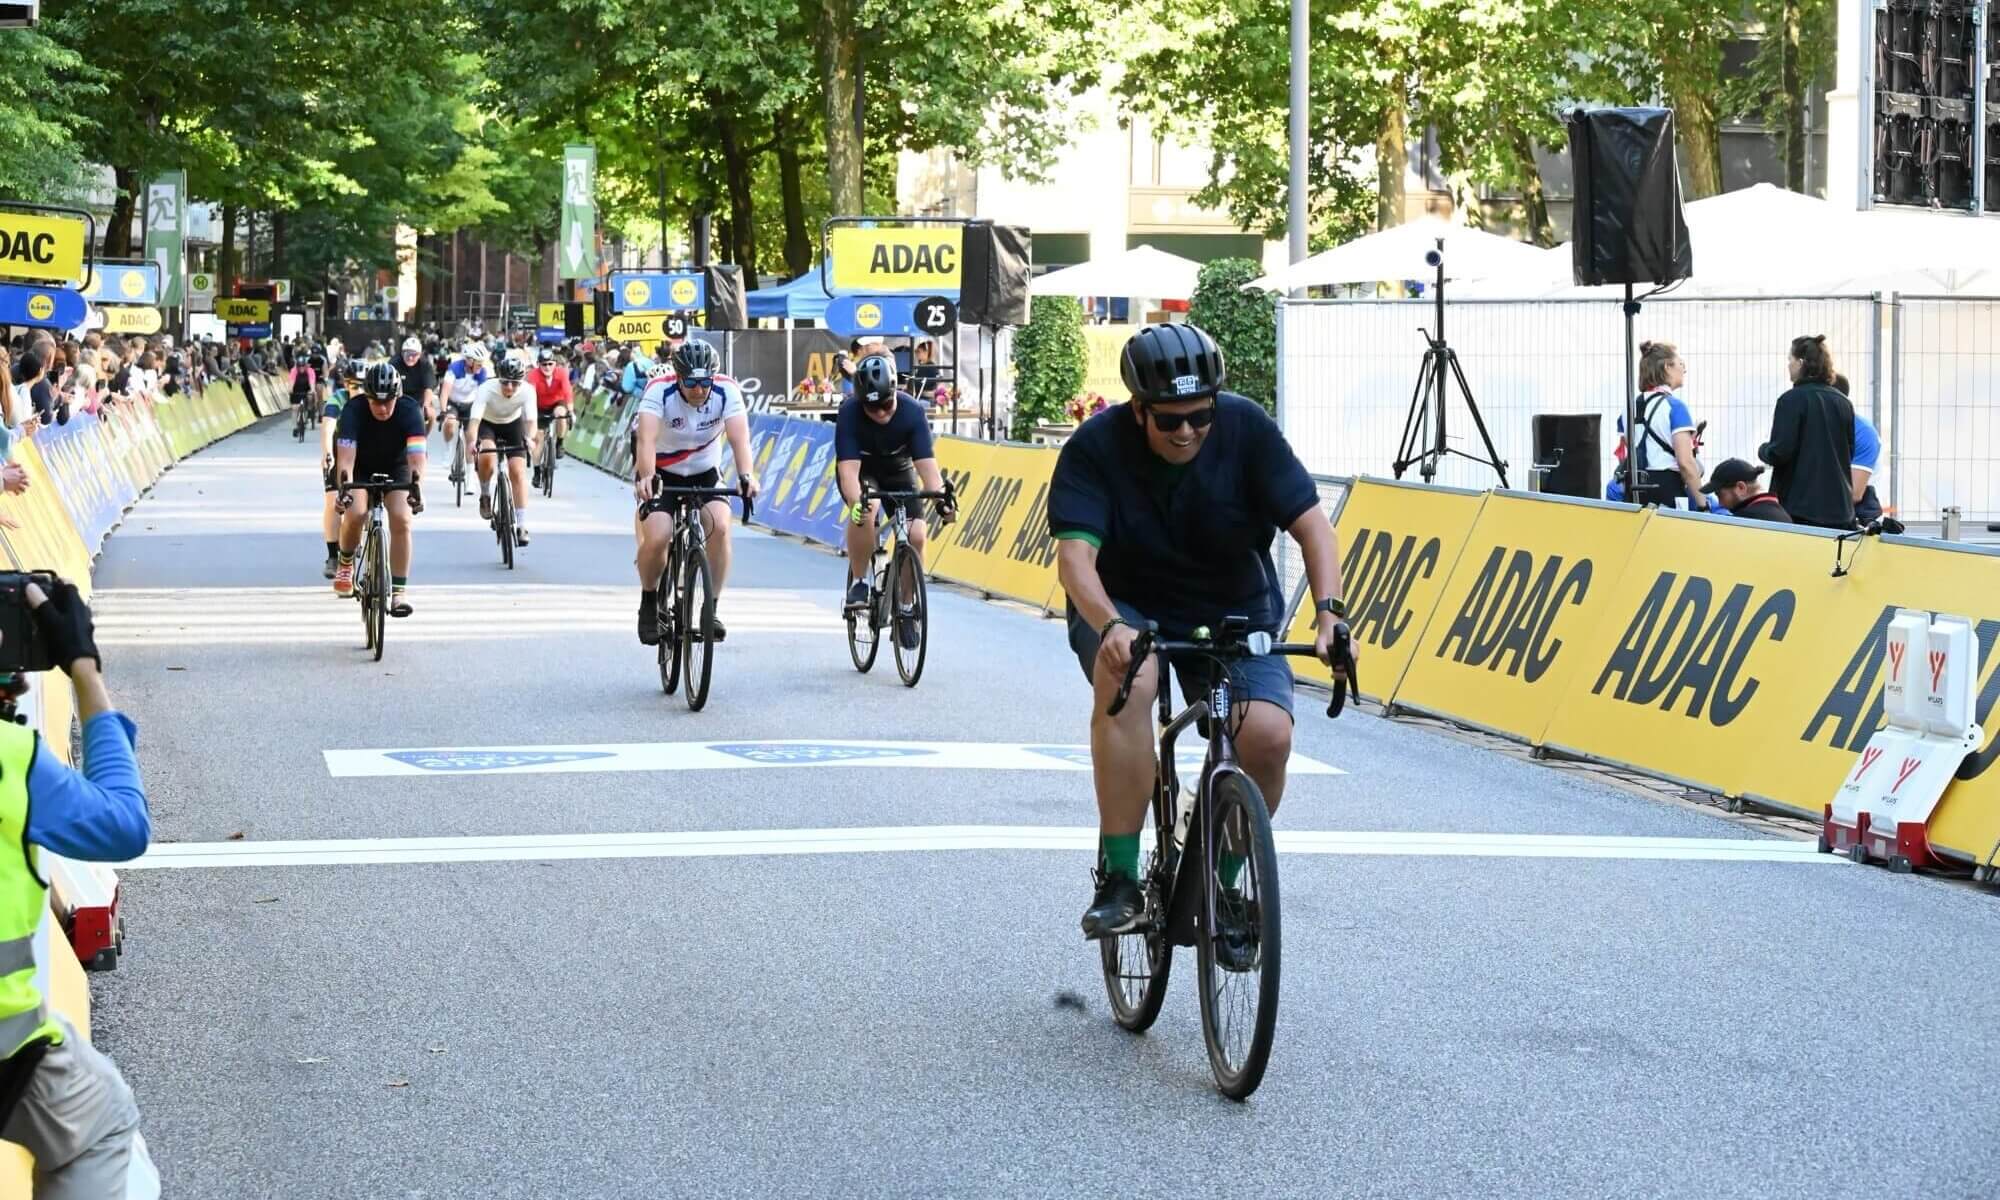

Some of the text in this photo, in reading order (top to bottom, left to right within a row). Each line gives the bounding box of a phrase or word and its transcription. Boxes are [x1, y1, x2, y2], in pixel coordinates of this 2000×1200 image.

[870, 244, 955, 274] ADAC
[119, 314, 151, 326] ADAC
[227, 305, 258, 316] ADAC
[552, 310, 566, 321] AD
[927, 305, 946, 327] 25
[618, 319, 684, 335] ADAC 50
[954, 476, 1023, 555] ADAC
[1310, 528, 1441, 650] ADAC
[1435, 546, 1593, 683] ADAC
[1591, 571, 1797, 728] ADAC
